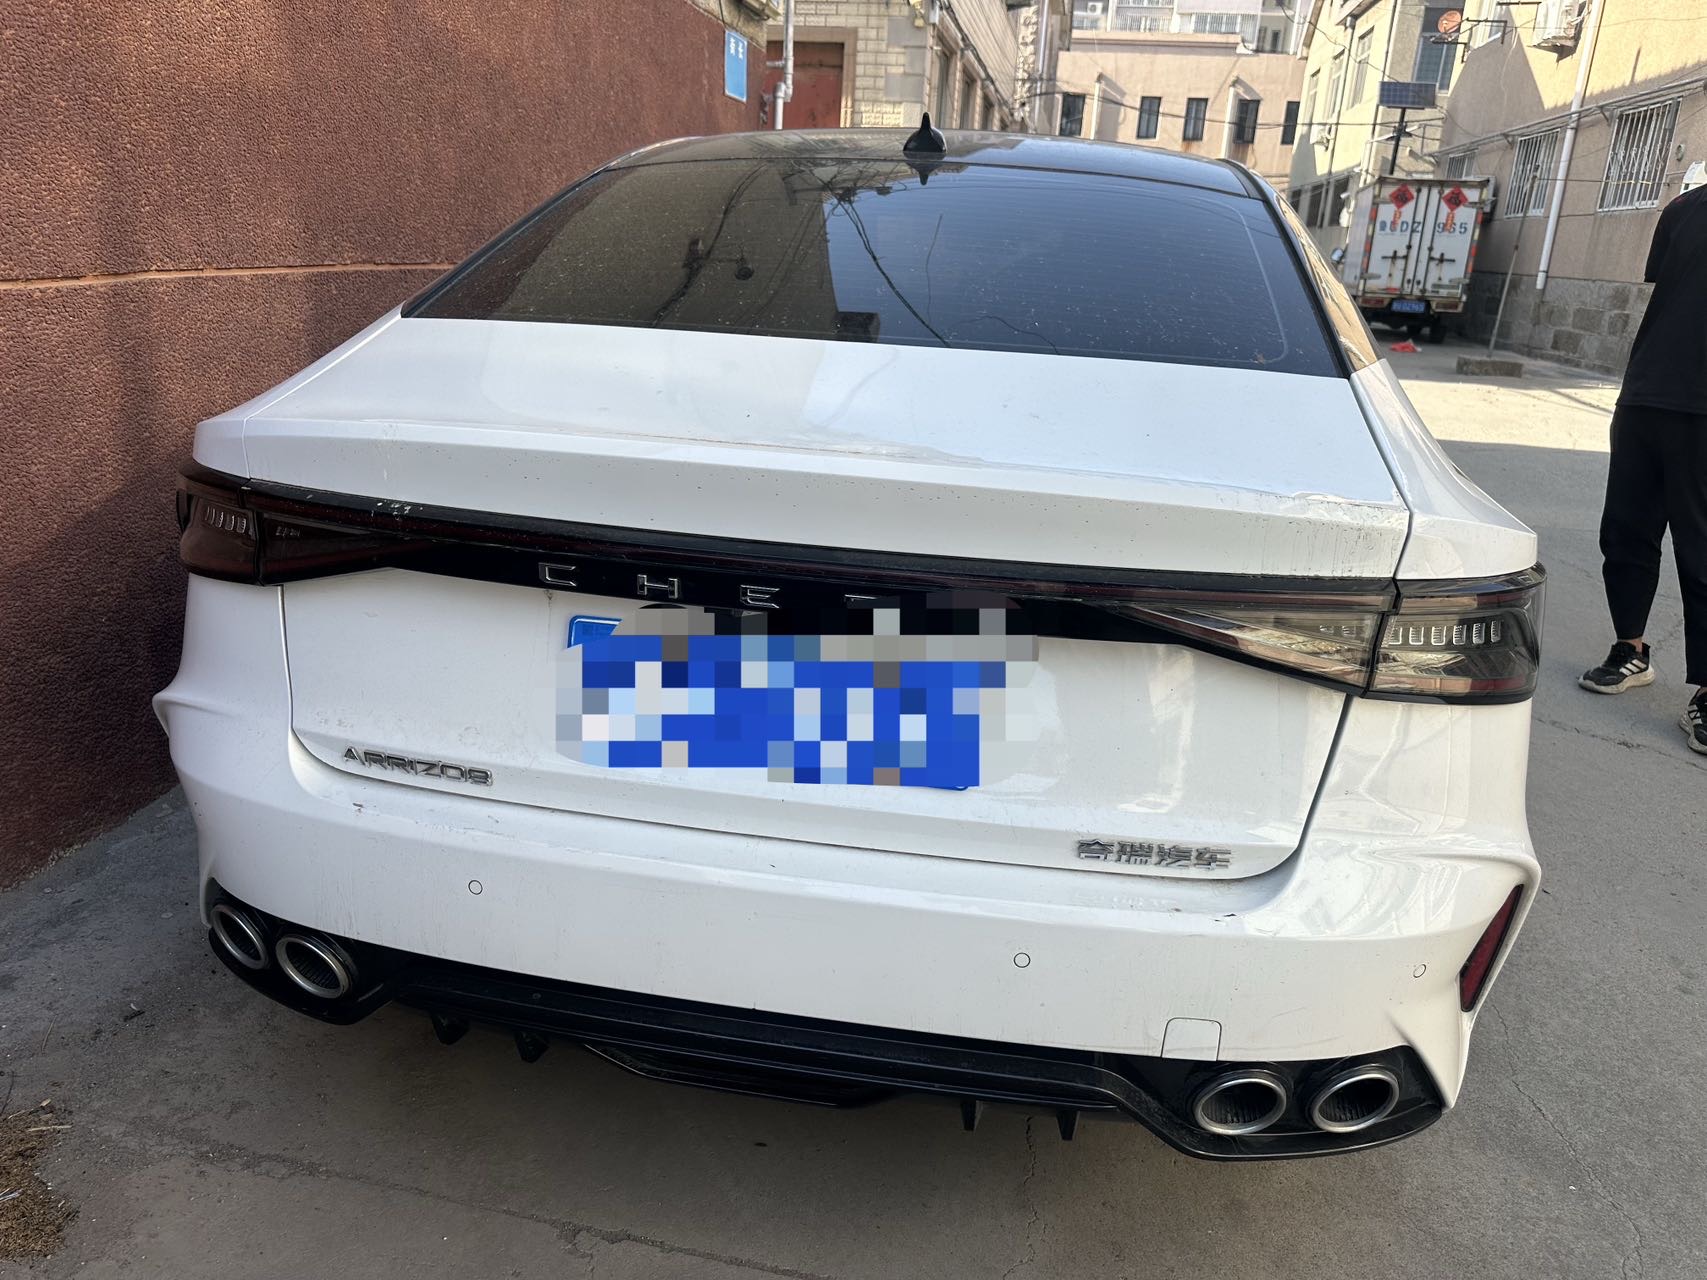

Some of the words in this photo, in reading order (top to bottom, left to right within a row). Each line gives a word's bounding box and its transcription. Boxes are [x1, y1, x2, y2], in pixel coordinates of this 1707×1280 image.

[538, 561, 878, 609] CHE
[1078, 838, 1232, 871] 奇瑞汽车
